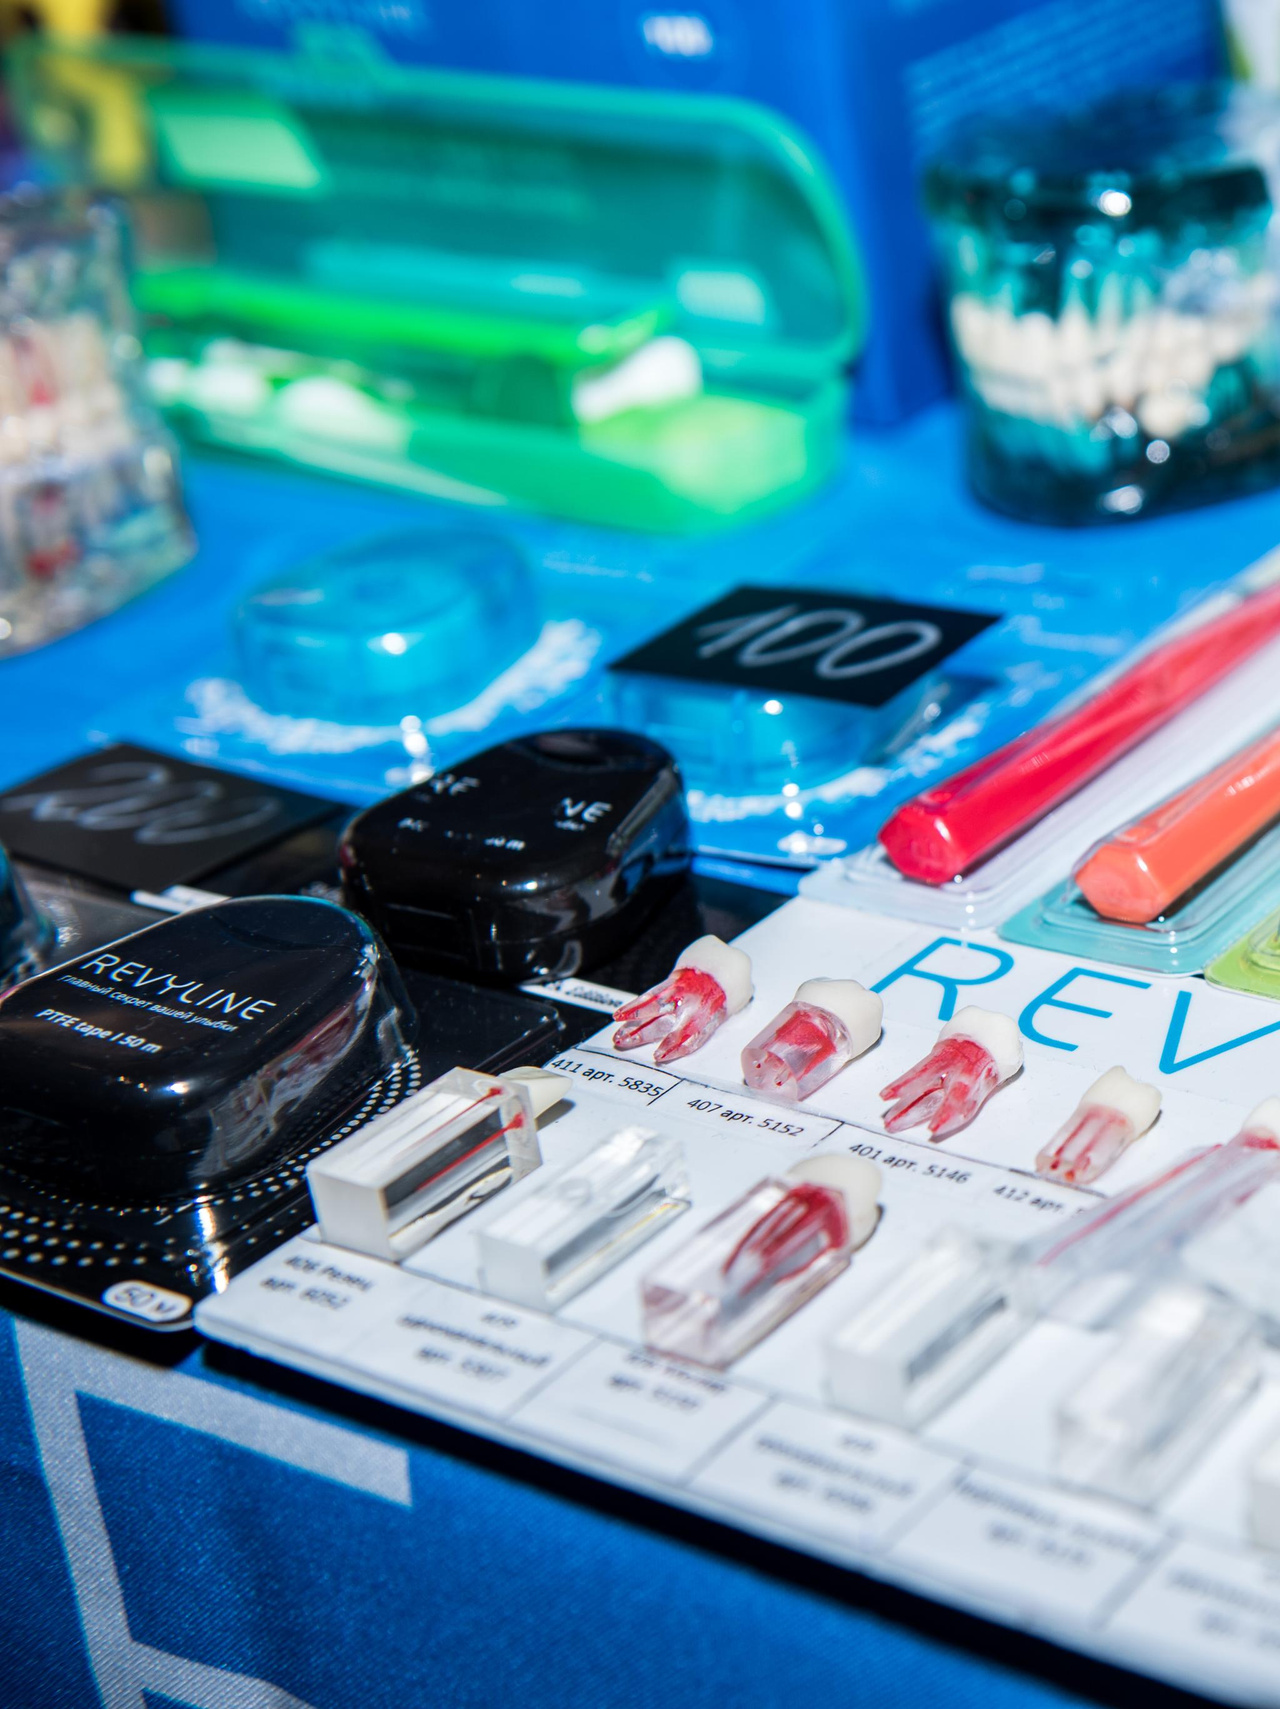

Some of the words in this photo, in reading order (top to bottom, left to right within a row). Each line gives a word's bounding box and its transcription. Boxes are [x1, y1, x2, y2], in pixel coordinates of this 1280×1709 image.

[697, 603, 942, 680] 100
[57, 974, 115, 996] главный
[108, 991, 154, 1009] секрет
[146, 1003, 195, 1021] вашей
[185, 1014, 239, 1033] улыбки
[80, 953, 277, 1021] REVYLINE
[34, 1008, 80, 1028] PTFE
[72, 1021, 113, 1039] tape
[117, 1035, 146, 1049] 50
[140, 1043, 162, 1055] m
[551, 1058, 579, 1074] 411
[582, 1067, 613, 1083] арт.
[617, 1076, 665, 1097] 5835
[686, 1098, 723, 1114] 407
[719, 1108, 754, 1125] арт.
[757, 1118, 805, 1137] 5152
[848, 1143, 883, 1161] 401
[883, 1155, 918, 1173] арт.
[922, 1164, 973, 1185] 5146
